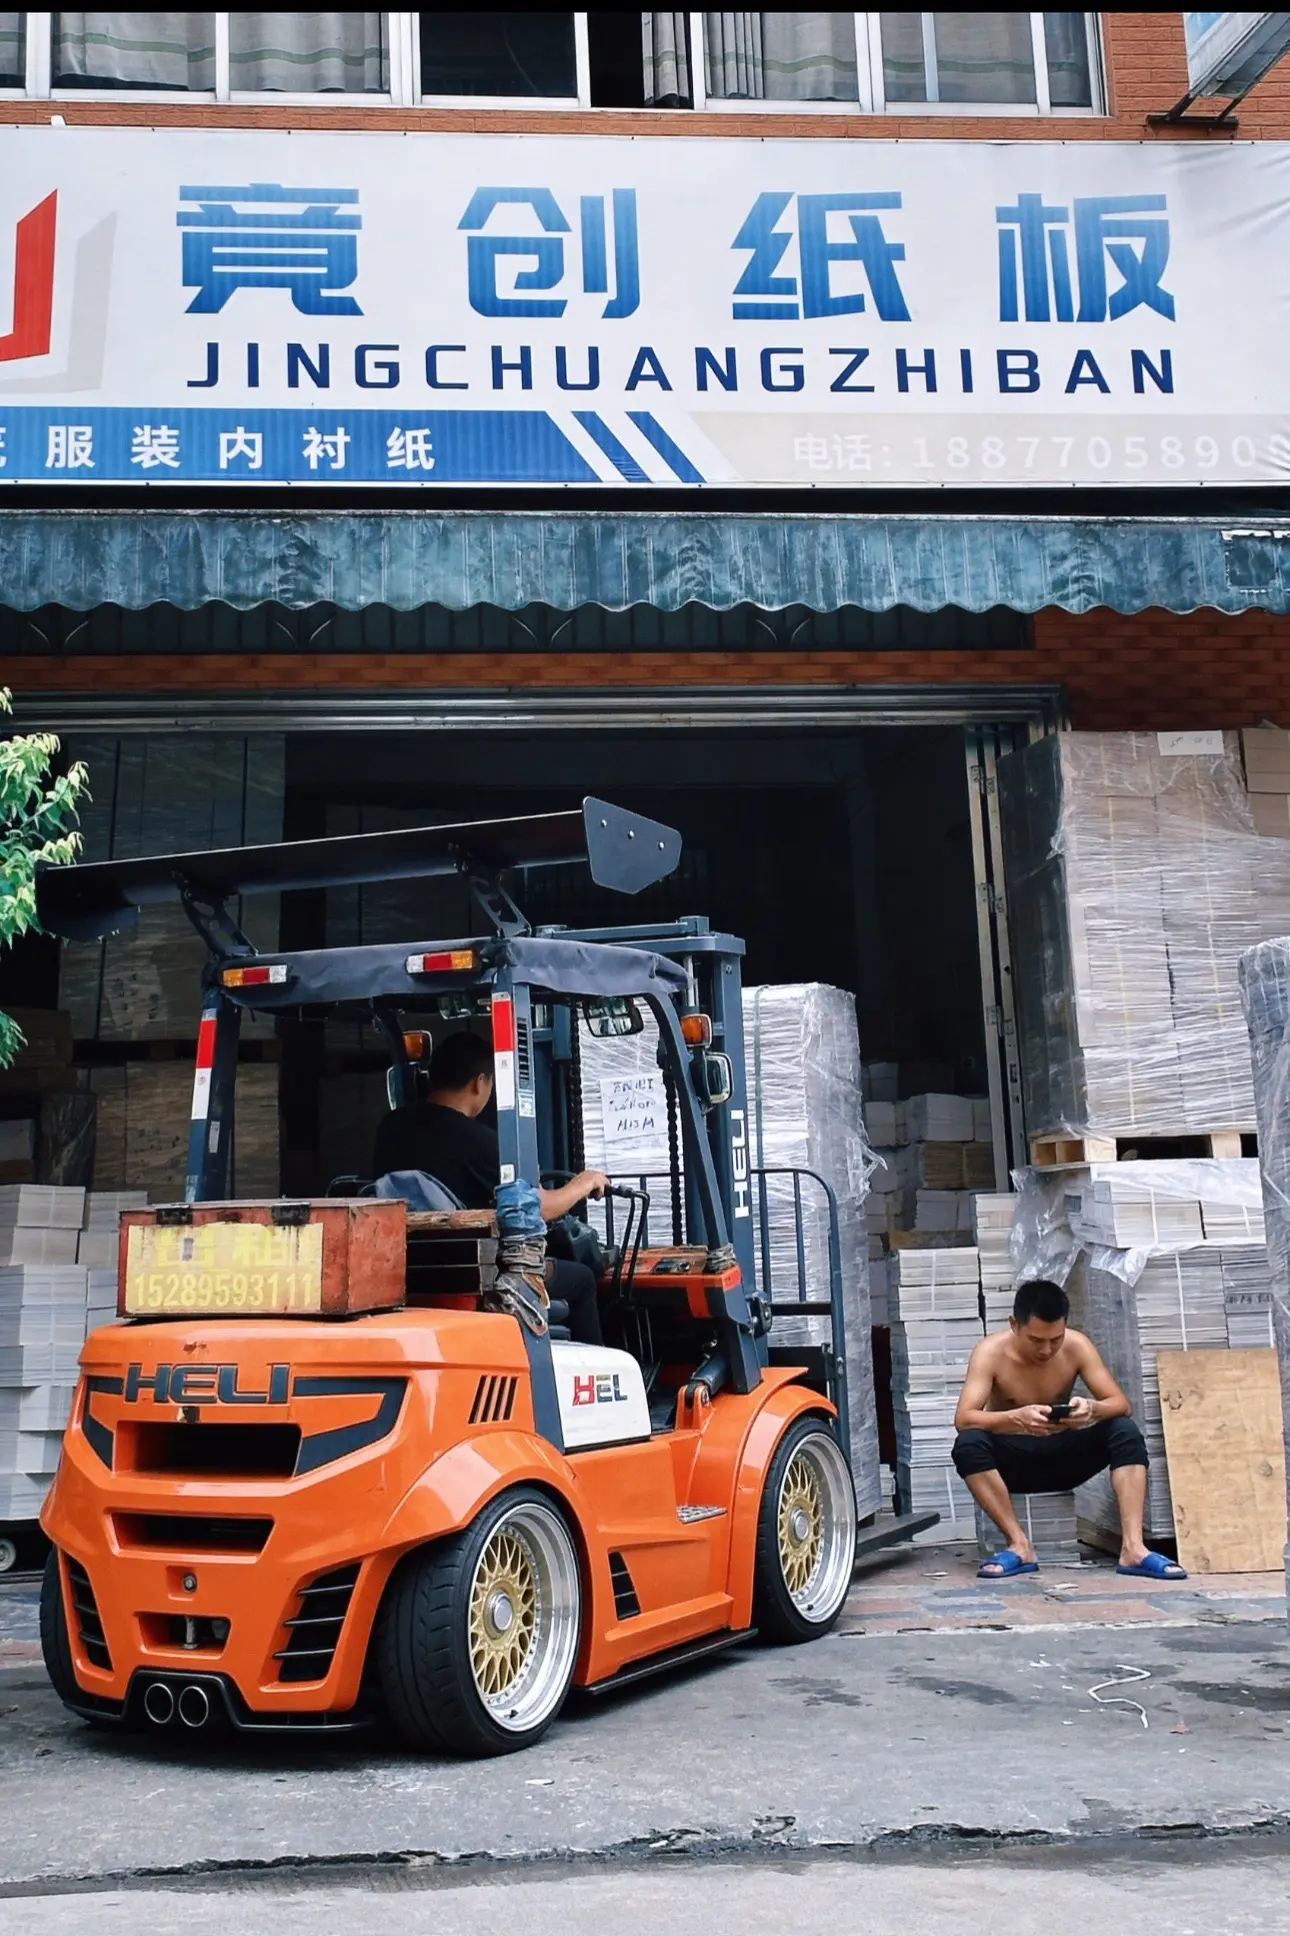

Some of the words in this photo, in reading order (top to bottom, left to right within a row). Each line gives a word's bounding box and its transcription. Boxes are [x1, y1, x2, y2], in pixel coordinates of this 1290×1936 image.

[187, 342, 1174, 395] JINGCHUANGZHIBAN
[0, 424, 436, 471] 服装内衬纸
[730, 1109, 750, 1219] HELI
[135, 1271, 313, 1308] 15289593111
[124, 1363, 291, 1404] HELI
